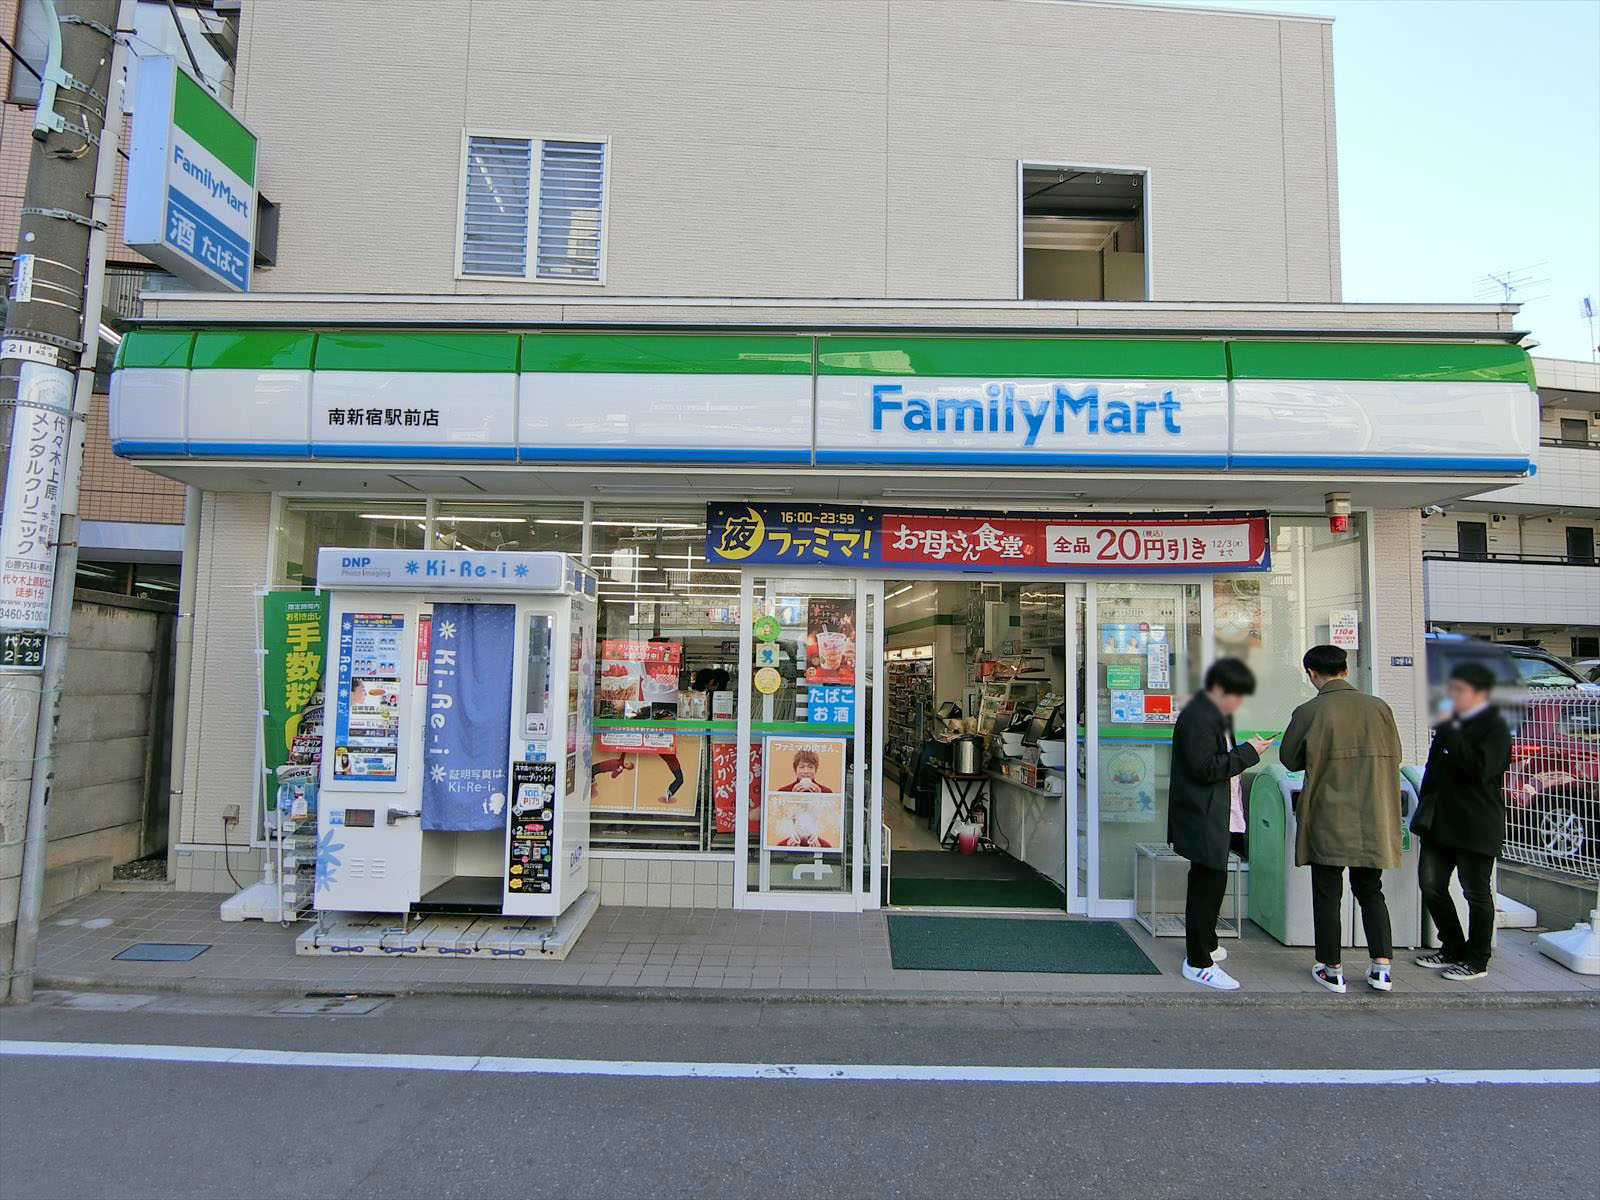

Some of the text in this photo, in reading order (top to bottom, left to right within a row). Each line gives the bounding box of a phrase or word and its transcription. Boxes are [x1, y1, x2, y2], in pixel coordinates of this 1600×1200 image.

[174, 145, 249, 219] FamilyMart
[170, 209, 245, 282] 酒 たばこ
[9, 344, 32, 354] 211
[328, 408, 440, 426] 南新宿駅前店
[871, 384, 1182, 446] FamilyMart
[44, 415, 66, 501] 代々木上原
[18, 412, 49, 555] メンタルクリニック
[768, 527, 873, 559] ファミマ!
[892, 523, 1024, 561] お母さん食堂
[1219, 549, 1234, 557] まで
[341, 558, 371, 568] DNP
[426, 560, 507, 578] Ki-Re-i
[362, 570, 391, 578] Imaging
[16, 588, 44, 599] 徒歩1分
[5, 636, 42, 647] 代々木
[4, 650, 40, 662] 2-29
[340, 635, 352, 685] Ki-Re-i
[429, 650, 456, 754] Ki-Re-i
[809, 688, 854, 704] たばこ
[813, 707, 850, 722] お酒
